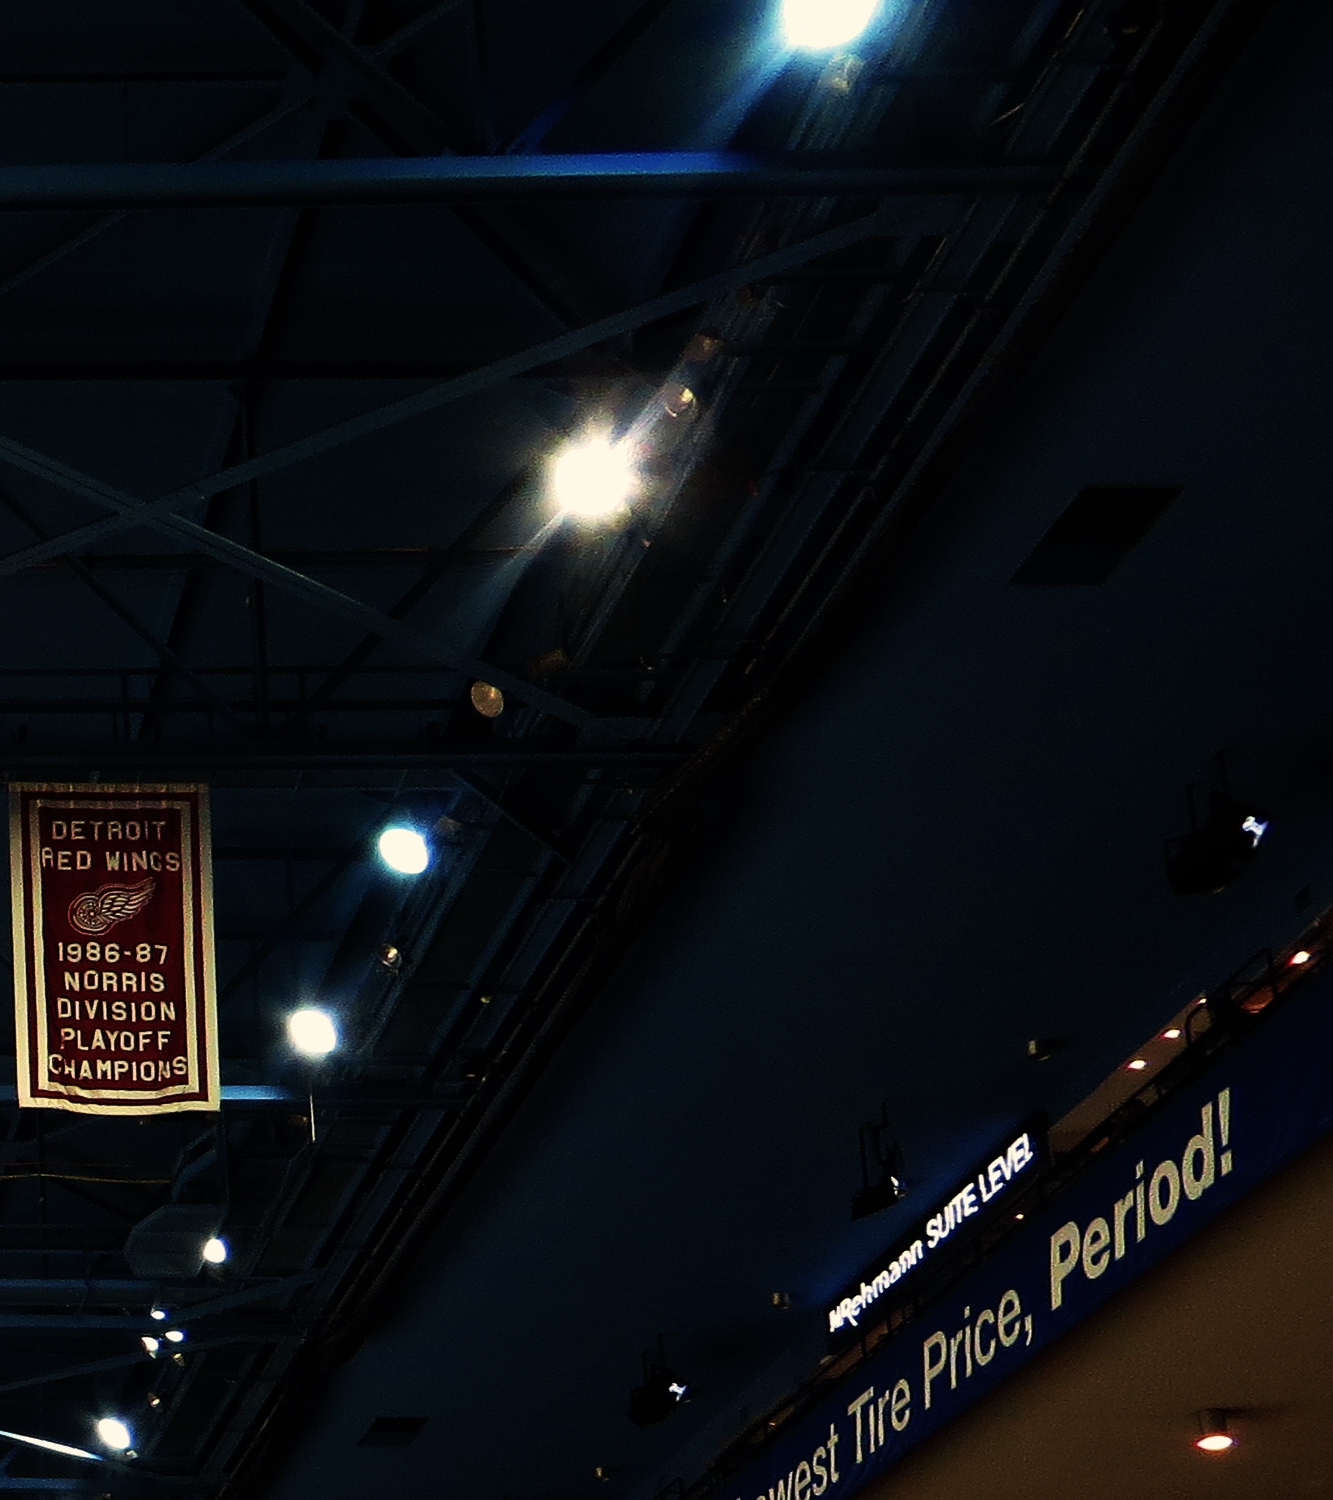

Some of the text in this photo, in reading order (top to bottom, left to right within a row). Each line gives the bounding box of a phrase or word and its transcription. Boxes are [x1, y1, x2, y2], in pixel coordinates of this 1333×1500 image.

[52, 821, 164, 841] DETROIT
[43, 849, 180, 872] RED WINGS
[58, 943, 168, 963] 1986-87
[65, 972, 164, 993] NORRIS
[58, 999, 175, 1021] DIVISION
[61, 1029, 171, 1051] PLAYOFF
[49, 1055, 187, 1082] CHAMPIONS
[840, 1133, 1033, 1326] Rehmann SUITE LEVEL
[847, 1388, 910, 1464] Tire
[923, 1289, 1033, 1410] Price,
[1051, 1087, 1232, 1310] Period!
